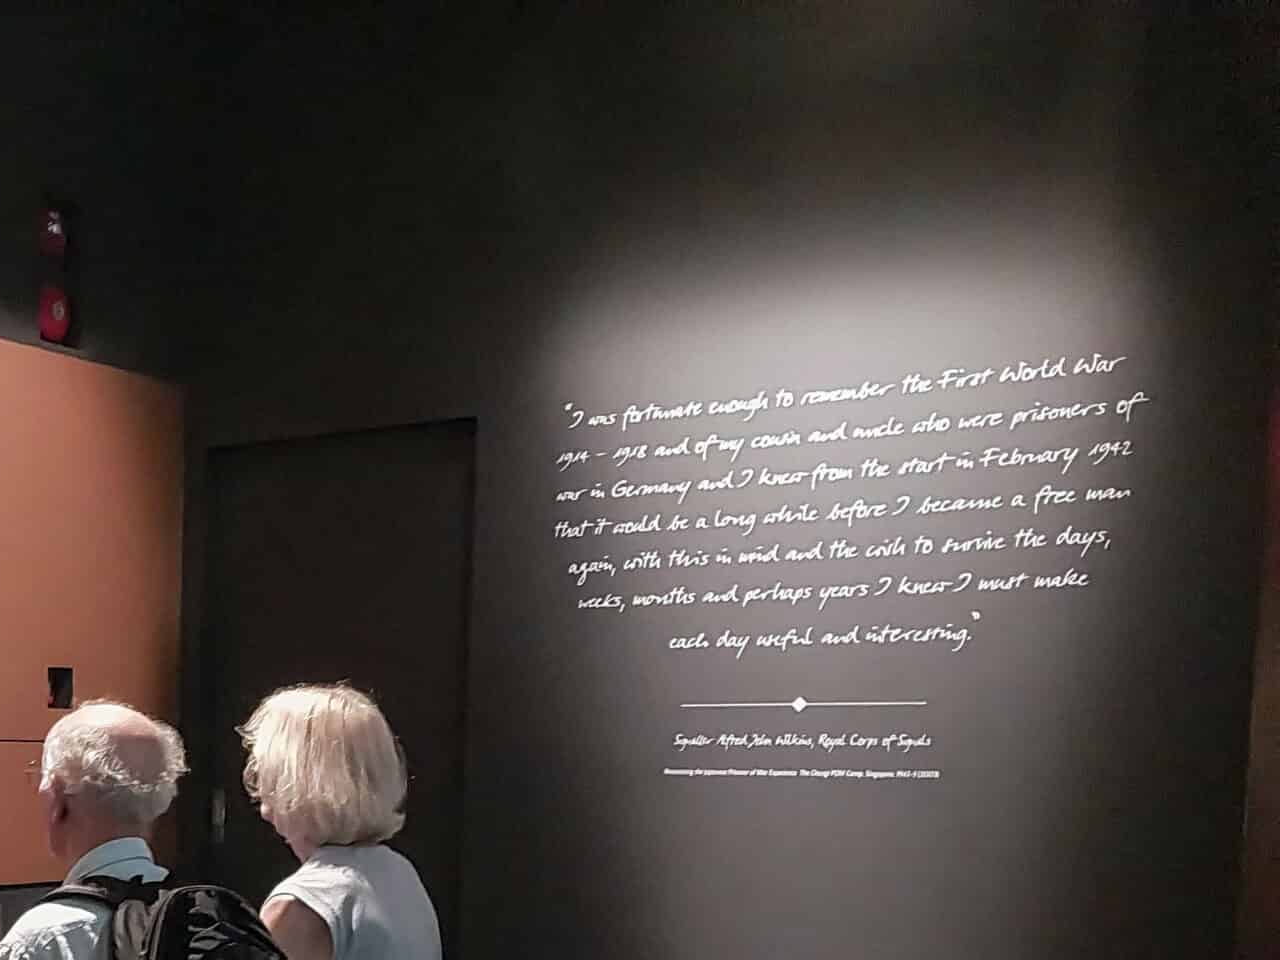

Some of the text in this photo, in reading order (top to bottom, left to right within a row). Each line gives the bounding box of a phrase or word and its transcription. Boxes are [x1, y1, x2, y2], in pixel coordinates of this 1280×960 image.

[588, 414, 617, 426] was
[622, 402, 702, 431] fortunate
[708, 391, 768, 422] enough
[775, 389, 793, 407] to
[800, 381, 895, 405] remember
[902, 375, 932, 394] the
[938, 368, 996, 388] First
[1000, 356, 1066, 382] World
[1073, 353, 1126, 374] War
[556, 450, 589, 471] 1914
[613, 445, 647, 467] 1918
[654, 437, 690, 457] and
[695, 434, 718, 460] of
[718, 438, 744, 462] my
[751, 431, 800, 448] cousin
[808, 422, 848, 442] and
[853, 417, 904, 438] uncle
[912, 413, 950, 433] who
[958, 412, 1003, 429] were
[1010, 402, 1107, 430] prisoners
[1116, 392, 1149, 422] of
[556, 440, 1134, 504] war in Germany and I knew from the start in February 1942
[555, 484, 1130, 537] that it would be a long while before I became a free man
[568, 525, 1111, 586] again, with this in mind and the wish to survive the days,
[578, 568, 1088, 612] weeks, months and perhaps years I knew I must make
[669, 632, 709, 649] each
[716, 630, 749, 659] day
[756, 627, 813, 651] useful
[821, 625, 860, 644] and
[818, 733, 846, 752] Royal
[850, 733, 878, 749] Corps
[881, 733, 898, 752] of
